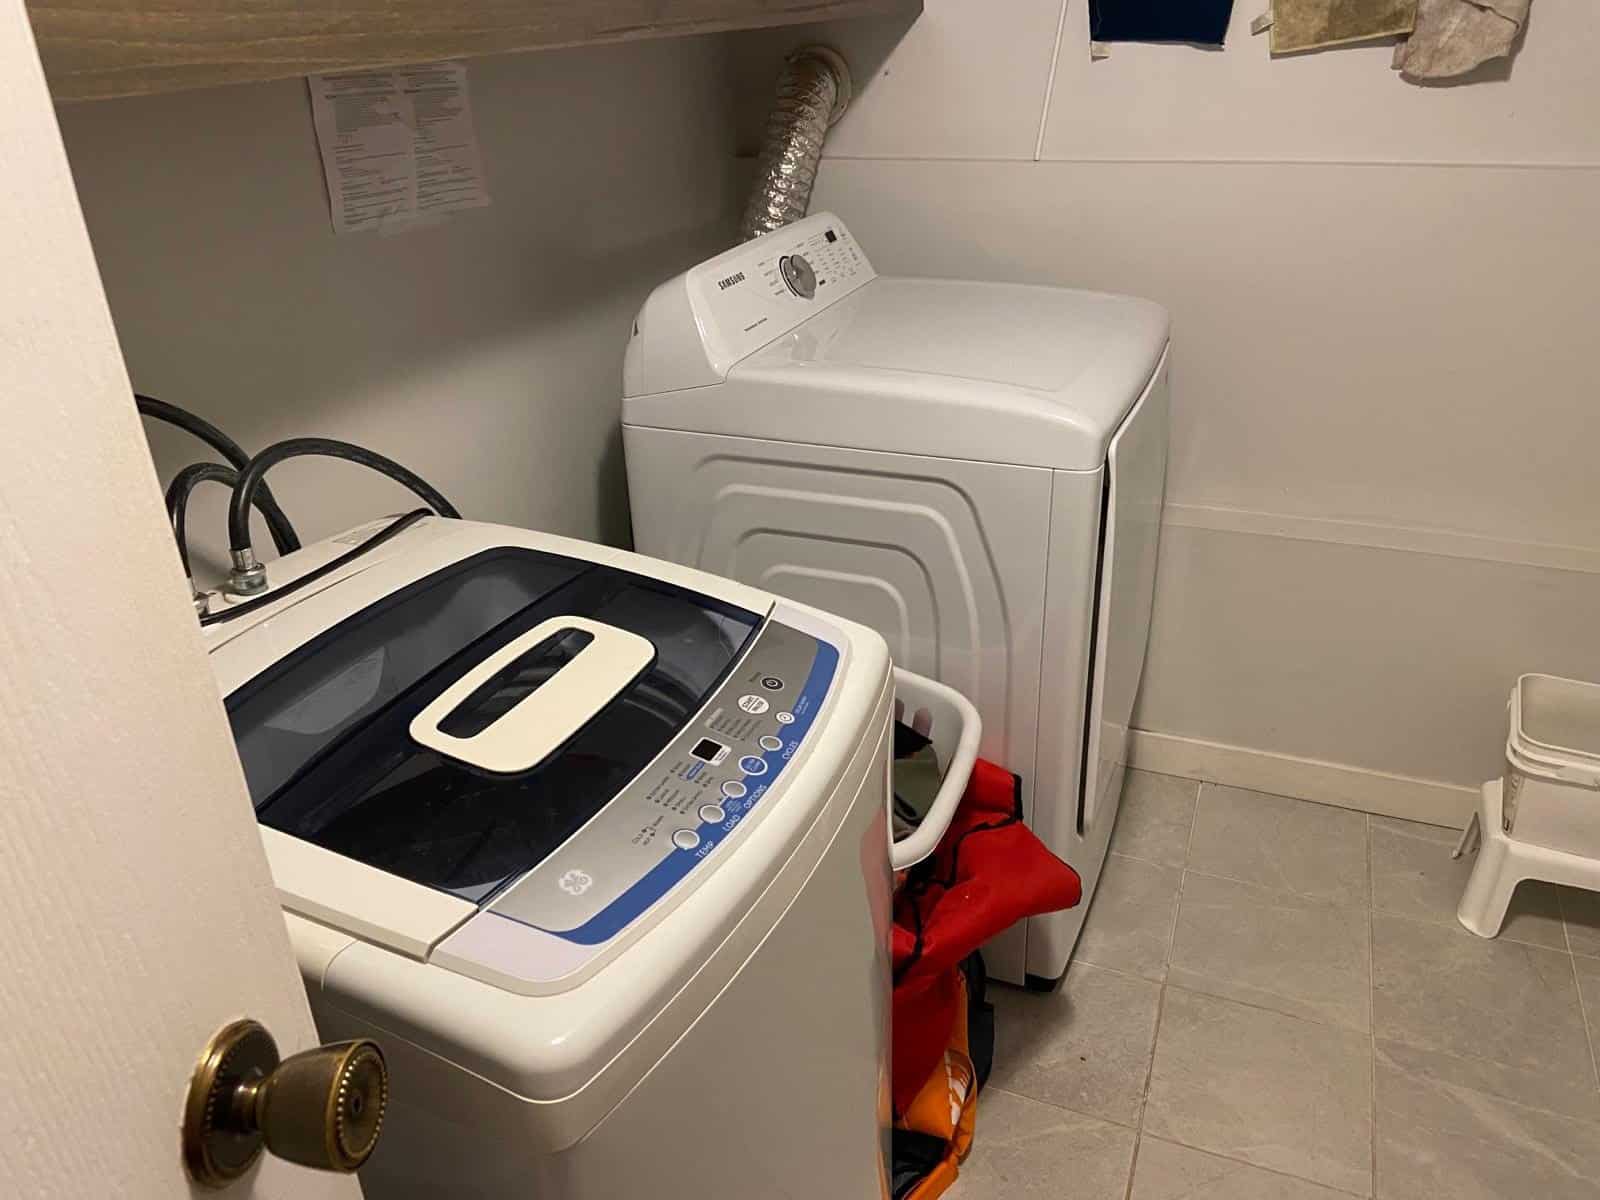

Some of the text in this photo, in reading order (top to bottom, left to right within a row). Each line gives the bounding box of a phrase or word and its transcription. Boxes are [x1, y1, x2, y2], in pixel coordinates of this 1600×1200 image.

[718, 271, 746, 290] SAMSUNG
[743, 784, 768, 809] OPTIONS
[721, 814, 742, 832] LOAD
[694, 839, 715, 858] TEMP
